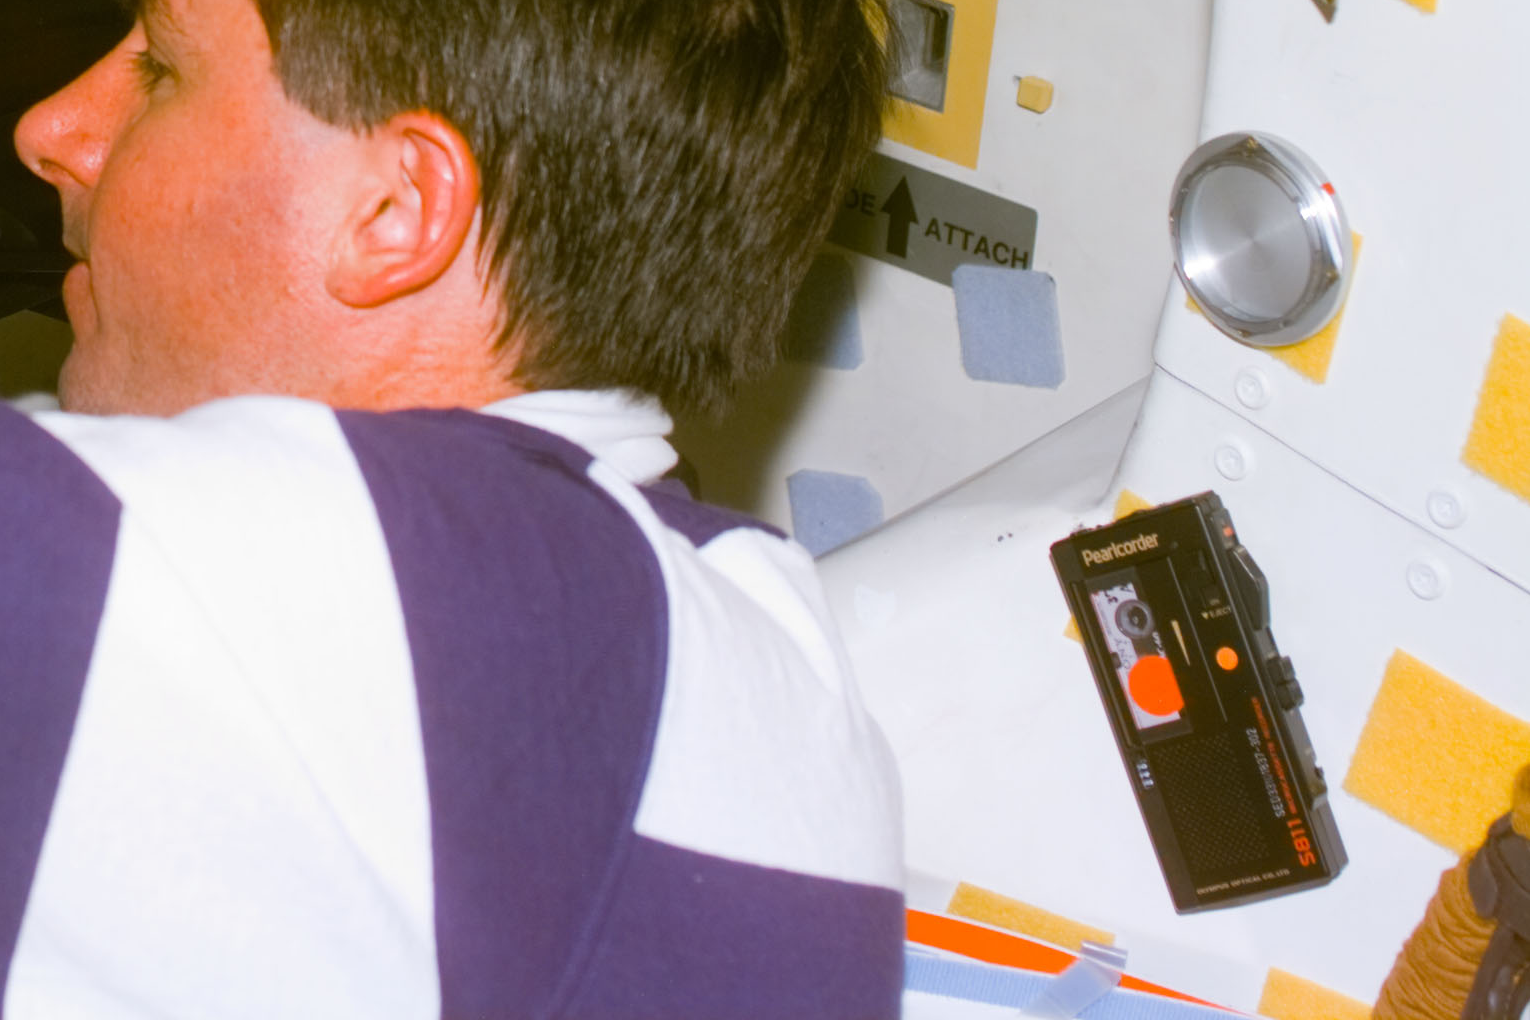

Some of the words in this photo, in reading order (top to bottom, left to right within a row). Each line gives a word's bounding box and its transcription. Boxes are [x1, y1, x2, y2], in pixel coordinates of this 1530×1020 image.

[924, 217, 1029, 270] ATTACH
[1081, 533, 1159, 567] Pearlcorder
[1286, 818, 1316, 868] S811
